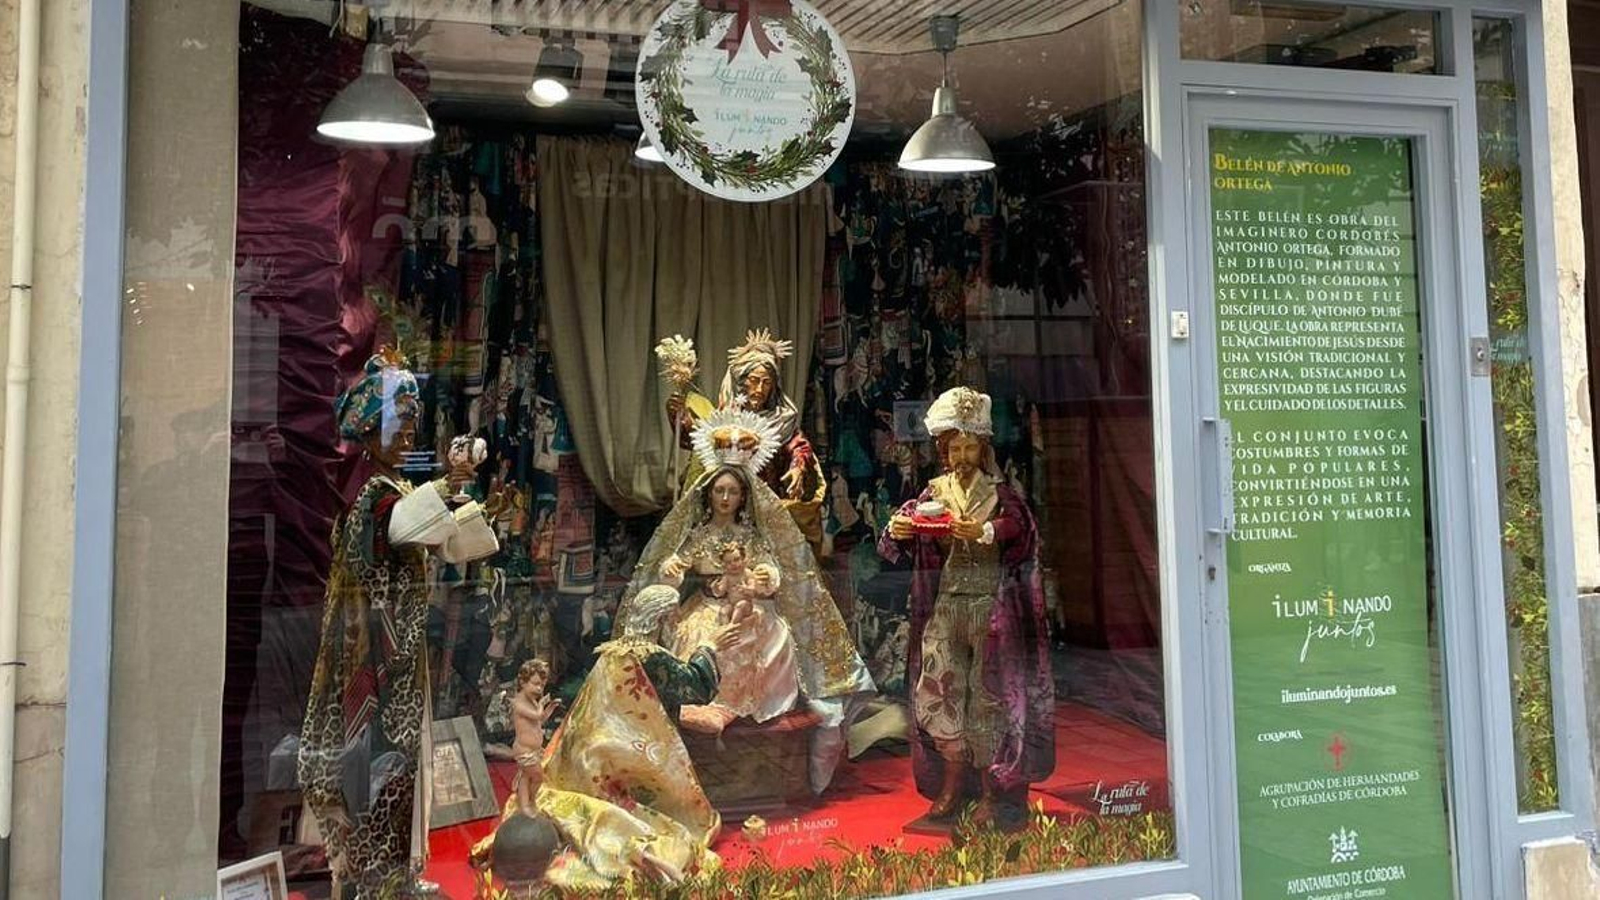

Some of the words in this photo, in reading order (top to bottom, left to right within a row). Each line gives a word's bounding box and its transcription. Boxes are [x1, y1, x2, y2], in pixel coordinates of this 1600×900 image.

[1287, 160, 1351, 176] ANTONIO
[1214, 177, 1272, 190] ORTEGA
[1216, 210, 1250, 221] ESTE
[1258, 210, 1300, 223] BELÉN
[1307, 213, 1322, 224] ES
[1329, 214, 1367, 226] OBRA
[1373, 215, 1399, 227] DEL
[1216, 226, 1308, 240] IMAGINERO
[1316, 229, 1400, 242] CORDOBÉS
[1216, 241, 1278, 255] ANTONIO
[1339, 245, 1401, 256] FORMADO
[1218, 257, 1237, 268] EN
[1316, 260, 1385, 272] PINTURA
[1393, 261, 1401, 272] Y
[1219, 273, 1296, 285] MODELADO
[1301, 274, 1317, 286] EN
[1394, 276, 1402, 287] Y
[1373, 291, 1403, 302] FUE
[1220, 302, 1288, 316] DISCÍPULO
[1293, 305, 1308, 316] DE
[1311, 305, 1366, 319] ANTONIO
[1221, 320, 1237, 331] DE
[1300, 321, 1328, 332] OBRA
[1330, 321, 1404, 333] REPRESENTA
[1222, 336, 1236, 347] EL
[1233, 334, 1316, 349] NACIMIENTO
[1317, 337, 1331, 348] DE
[1366, 337, 1406, 348] DESDE
[1222, 351, 1250, 363] UNA
[1255, 349, 1304, 363] VISIÓN
[1309, 352, 1392, 363] TRADICIONAL
[1398, 352, 1405, 363] Y
[1300, 367, 1384, 379] DESTACANDO
[1390, 367, 1406, 379] LA
[1224, 383, 1313, 396] EXPRESIVIDAD
[1316, 383, 1331, 395] DE
[1333, 383, 1352, 394] LAS
[1355, 383, 1407, 395] FIGURAS
[1225, 400, 1232, 411] Y
[1234, 400, 1247, 411] EL
[1248, 399, 1311, 411] CUIDADO
[1312, 399, 1326, 410] DE
[1327, 399, 1347, 410] LOS
[1253, 430, 1347, 444] CONJUNTO
[1353, 429, 1409, 441] EVOCA
[1325, 445, 1333, 456] Y
[1337, 445, 1386, 457] FORMAS
[1391, 444, 1409, 456] DE
[1359, 477, 1375, 488] EN
[1380, 476, 1410, 488] UNA
[1341, 493, 1359, 505] DE
[1331, 509, 1340, 522] Y
[1347, 506, 1411, 520] MEMORIA
[1281, 684, 1397, 704] iluminandojuntos.es
[1326, 778, 1340, 790] DE
[1343, 770, 1420, 788] HERMANDADES
[1272, 798, 1279, 810] Y
[1339, 789, 1353, 802] DE
